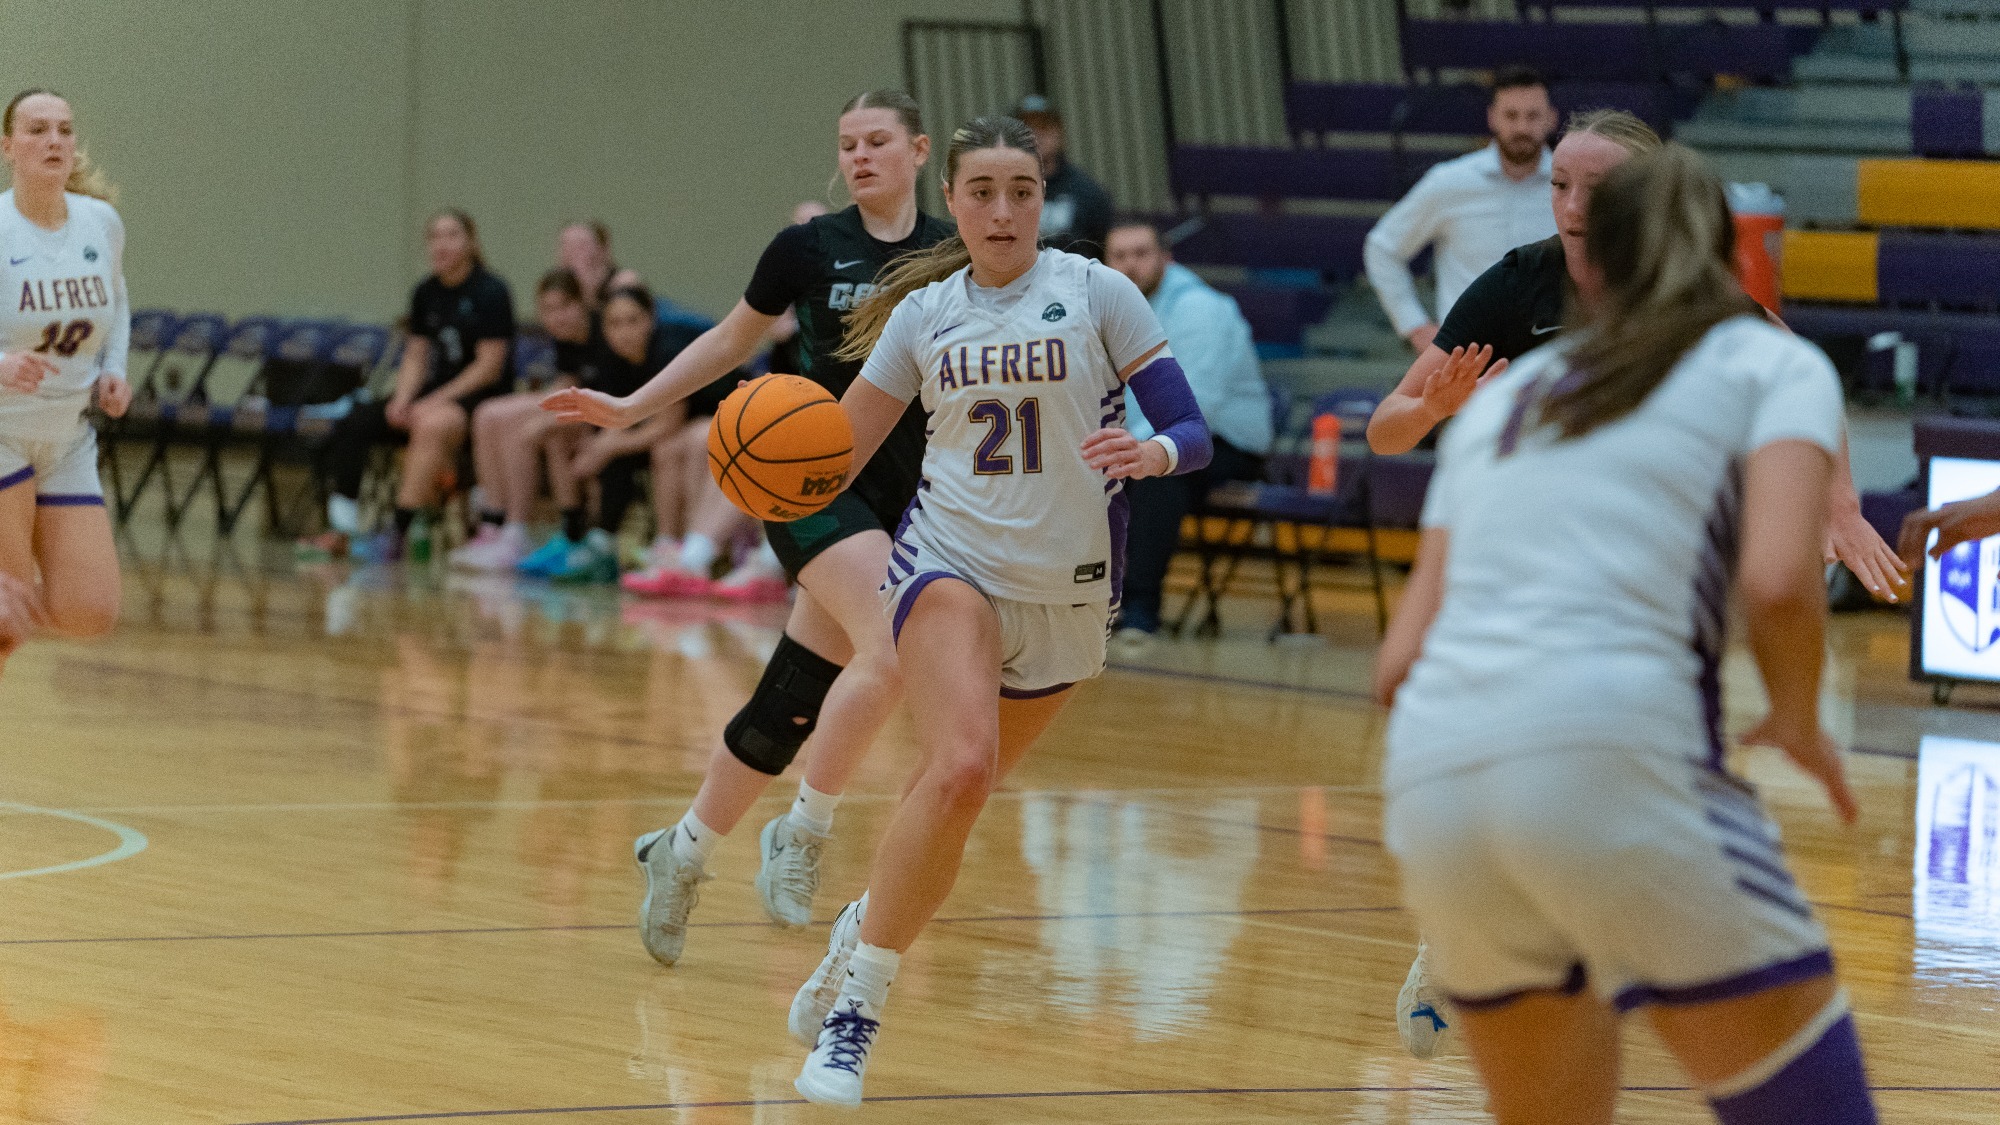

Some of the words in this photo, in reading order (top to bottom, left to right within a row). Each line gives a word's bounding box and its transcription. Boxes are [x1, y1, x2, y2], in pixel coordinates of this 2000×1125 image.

[19, 276, 108, 312] ALFRED
[939, 338, 1067, 392] ALFRED
[968, 397, 1042, 476] 21
